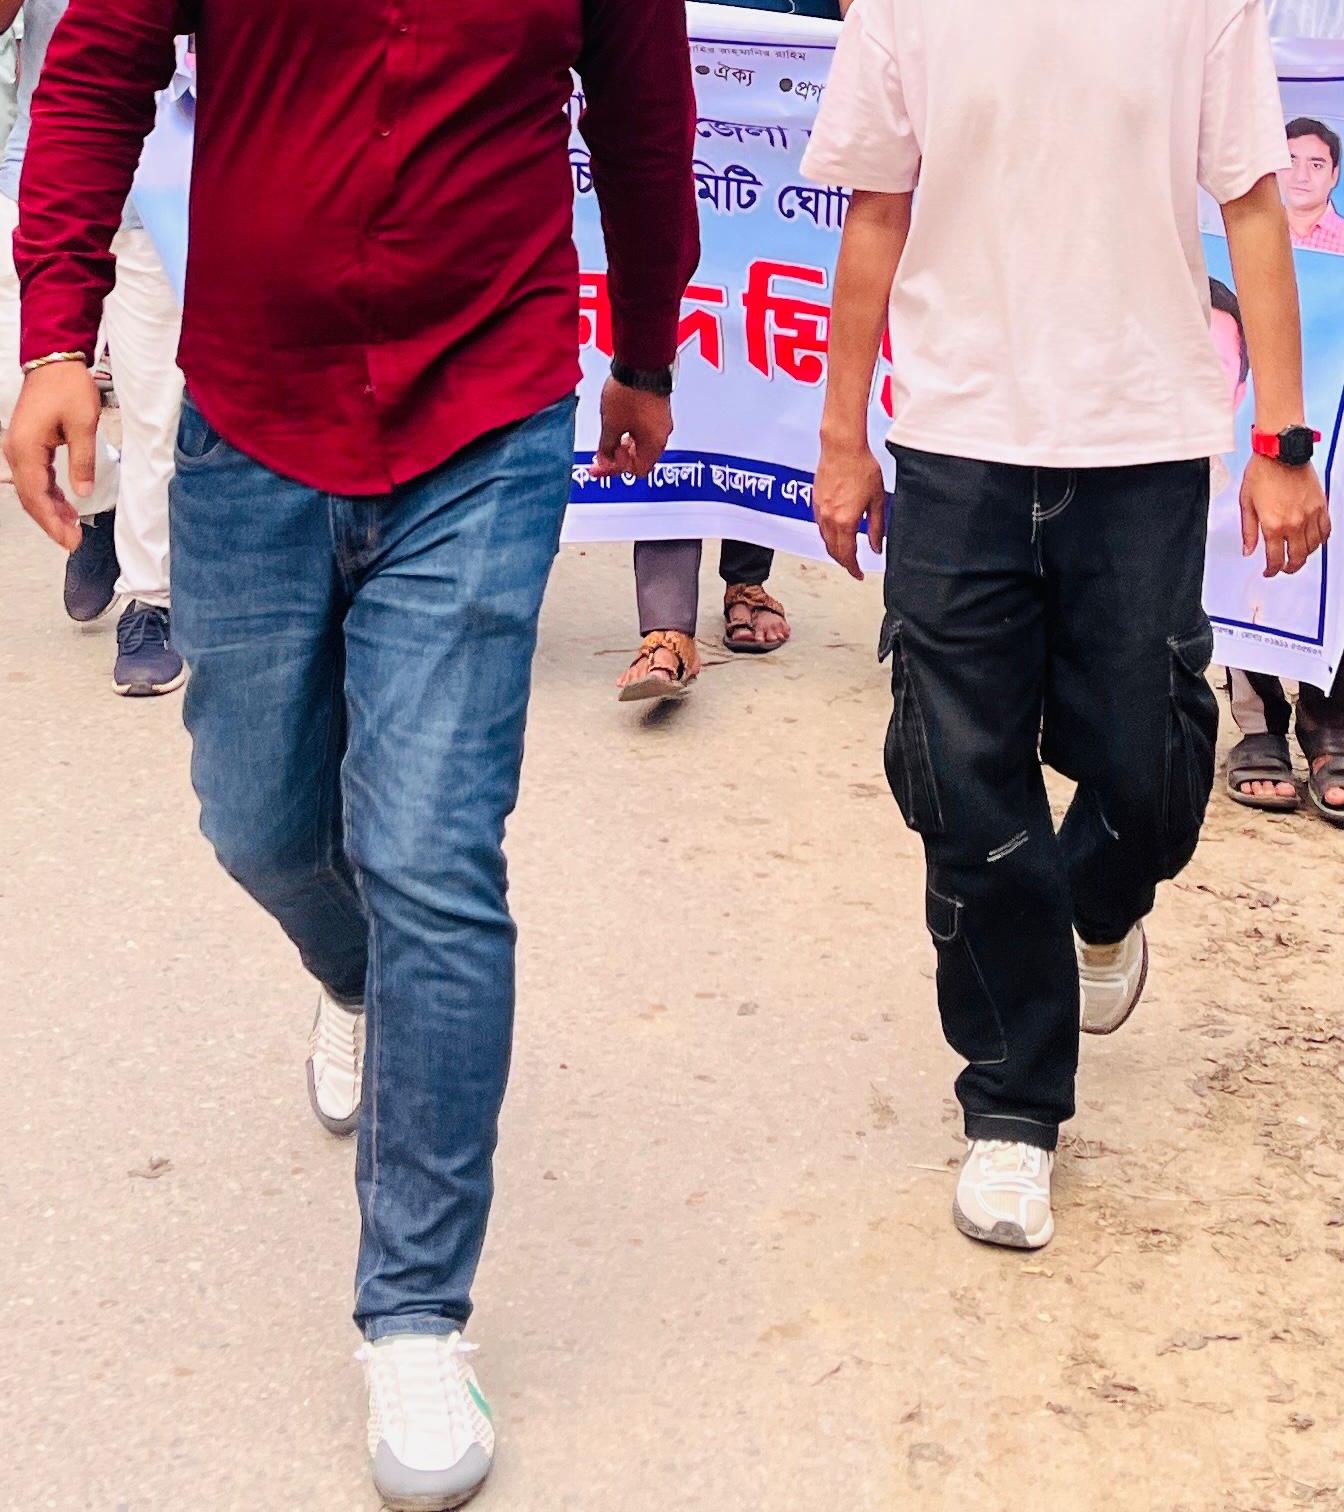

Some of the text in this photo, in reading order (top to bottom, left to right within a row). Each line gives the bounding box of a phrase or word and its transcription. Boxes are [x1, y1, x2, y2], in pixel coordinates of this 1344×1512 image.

[713, 62, 824, 103] ঐক্য প্রগ
[696, 118, 788, 149] জেলা
[693, 159, 763, 211] মিটি
[743, 260, 832, 383] মি
[709, 463, 776, 500] ছাত্রদল
[781, 477, 813, 507] এব
